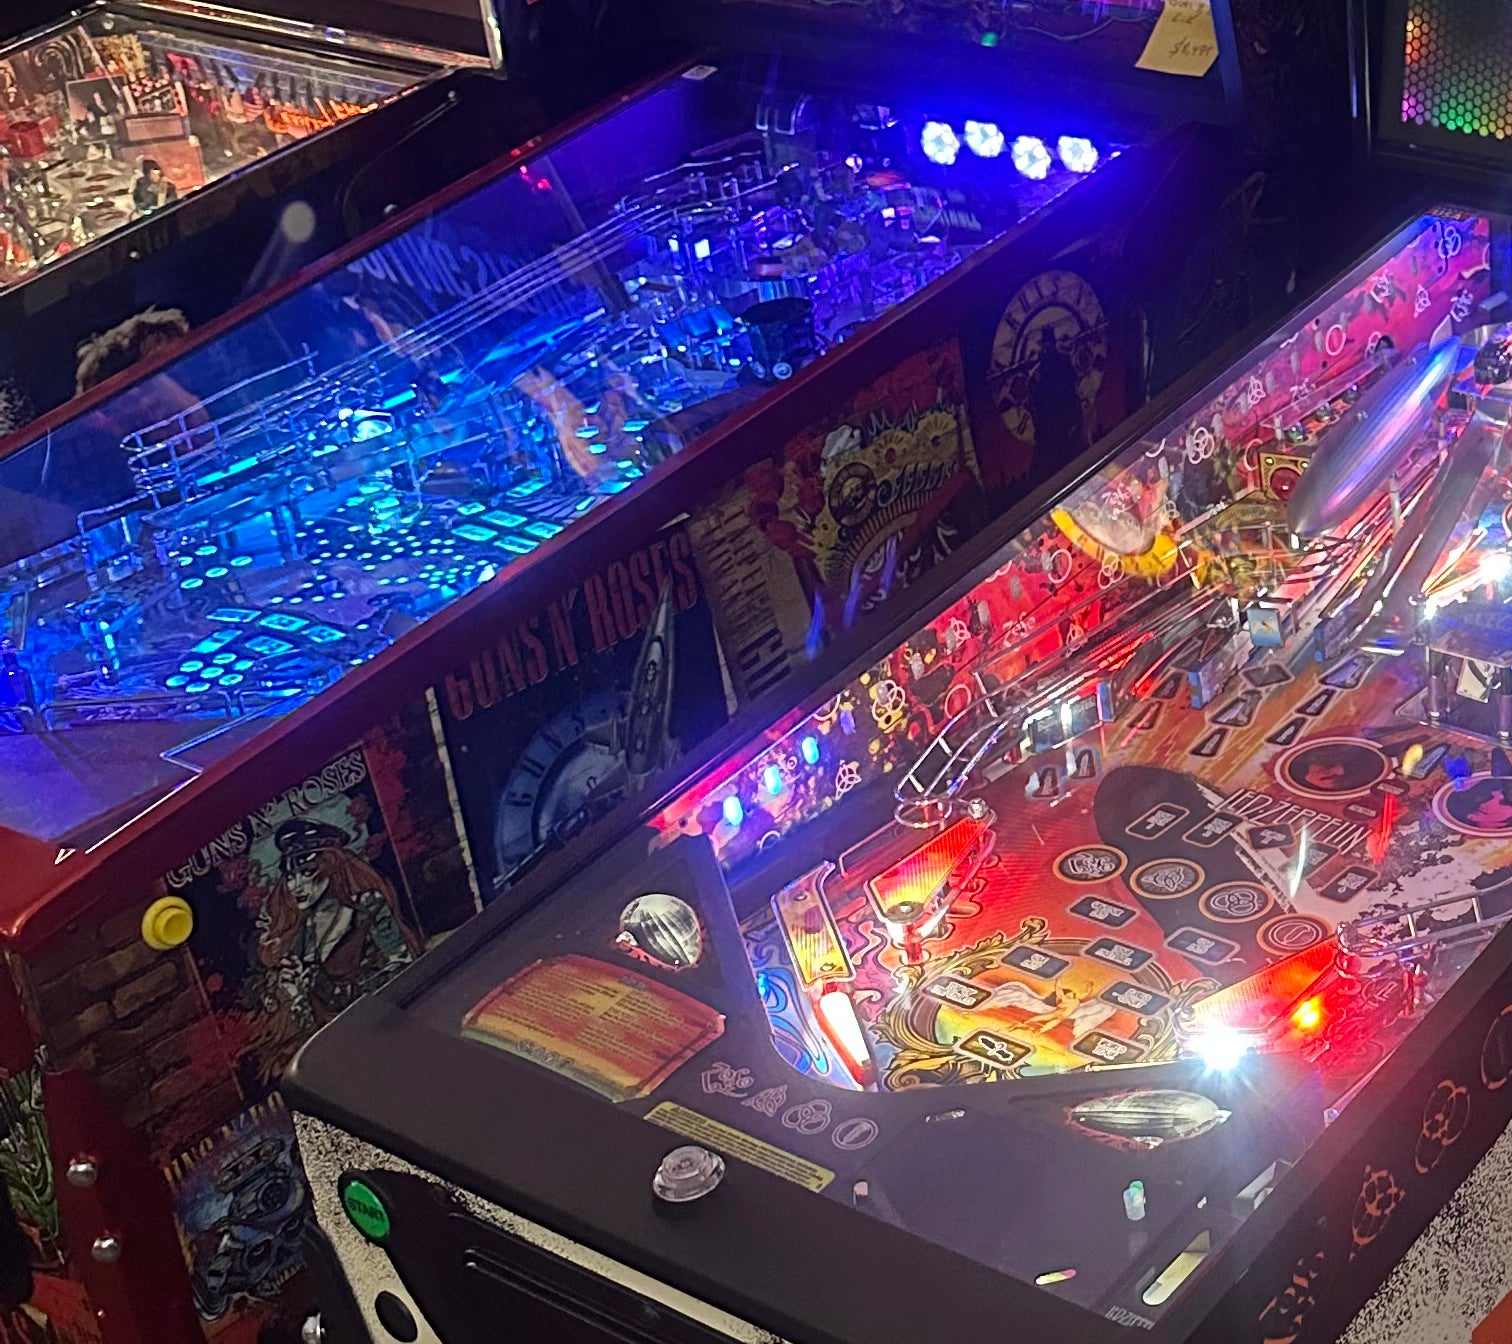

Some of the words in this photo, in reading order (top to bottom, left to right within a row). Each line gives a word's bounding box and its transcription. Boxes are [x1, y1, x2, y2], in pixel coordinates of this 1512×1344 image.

[584, 531, 698, 653] ROSES
[167, 821, 248, 888] GUNS
[283, 750, 367, 817] ROSES
